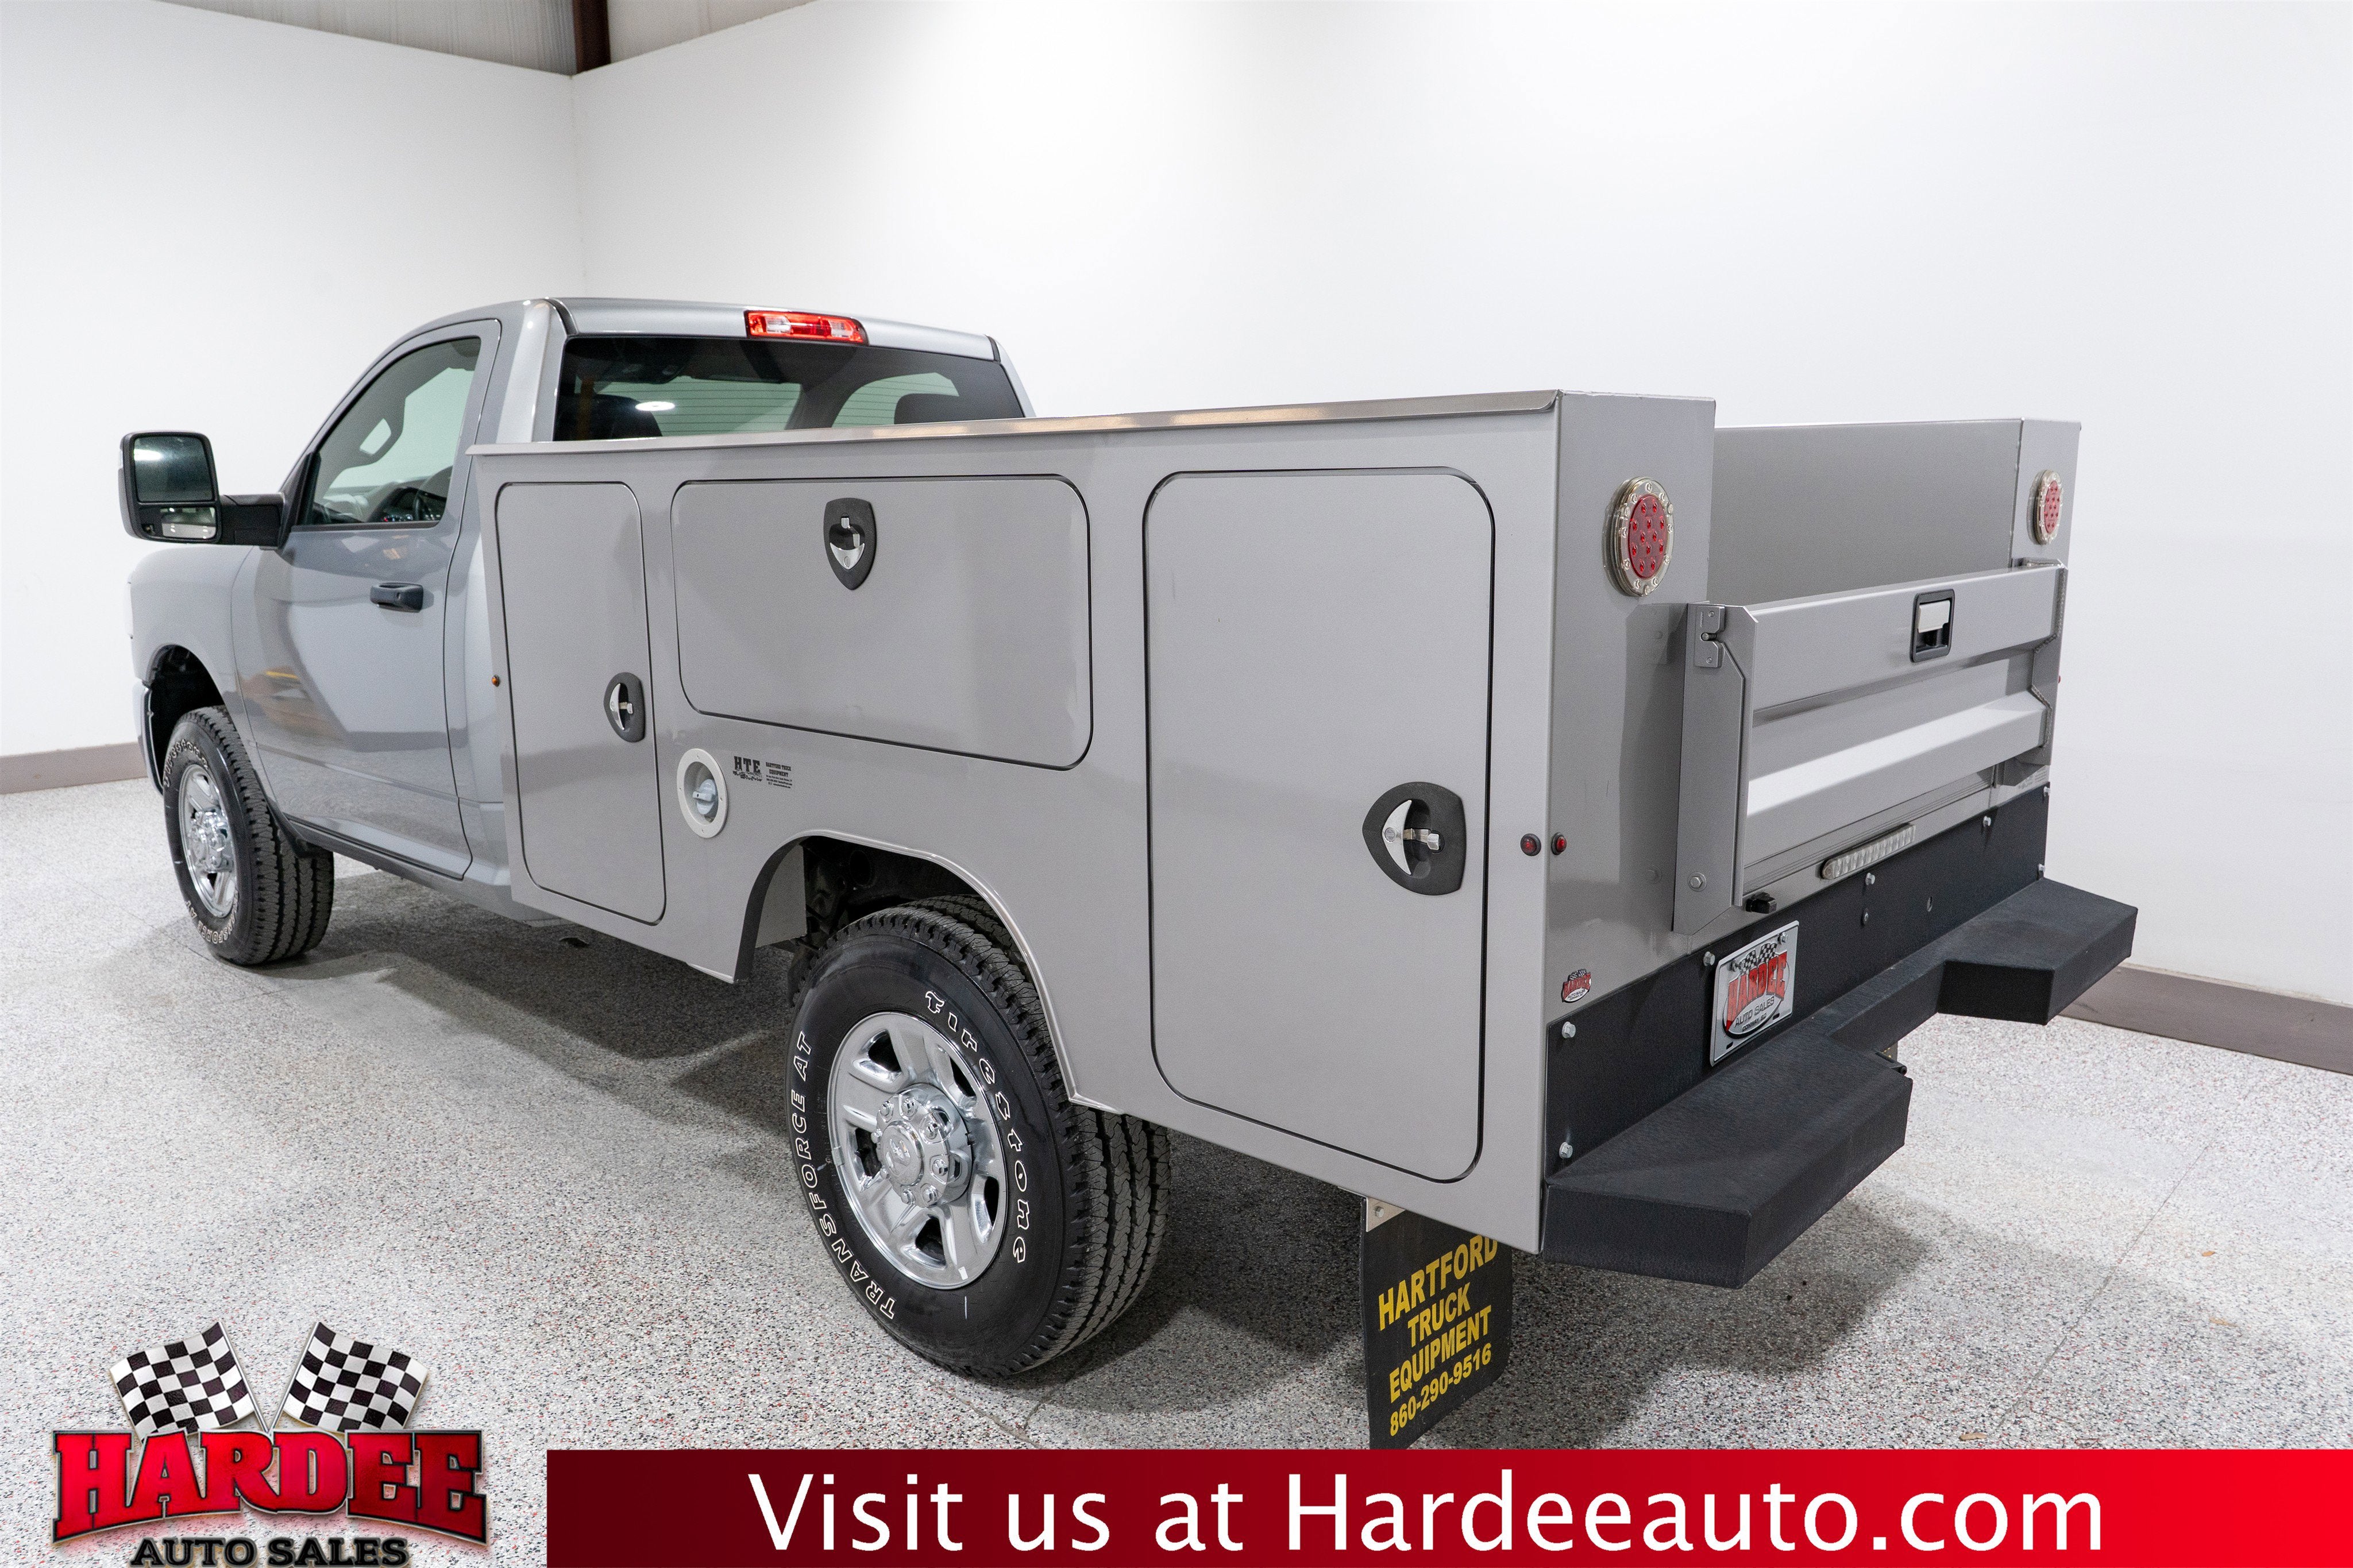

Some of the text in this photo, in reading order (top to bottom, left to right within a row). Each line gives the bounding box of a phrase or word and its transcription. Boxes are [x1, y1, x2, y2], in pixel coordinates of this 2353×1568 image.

[734, 756, 761, 773] HTE
[1726, 949, 1787, 1031] HARDEE
[1734, 995, 1775, 1028] AUTO SALES
[791, 1030, 896, 1320] TRANSFORCE AT
[1379, 1234, 1498, 1331] HARTFORD
[1407, 1282, 1471, 1347] TRUCK
[1389, 1304, 1492, 1404] EQUIPMENT
[1390, 1342, 1492, 1436] 860-290-9516
